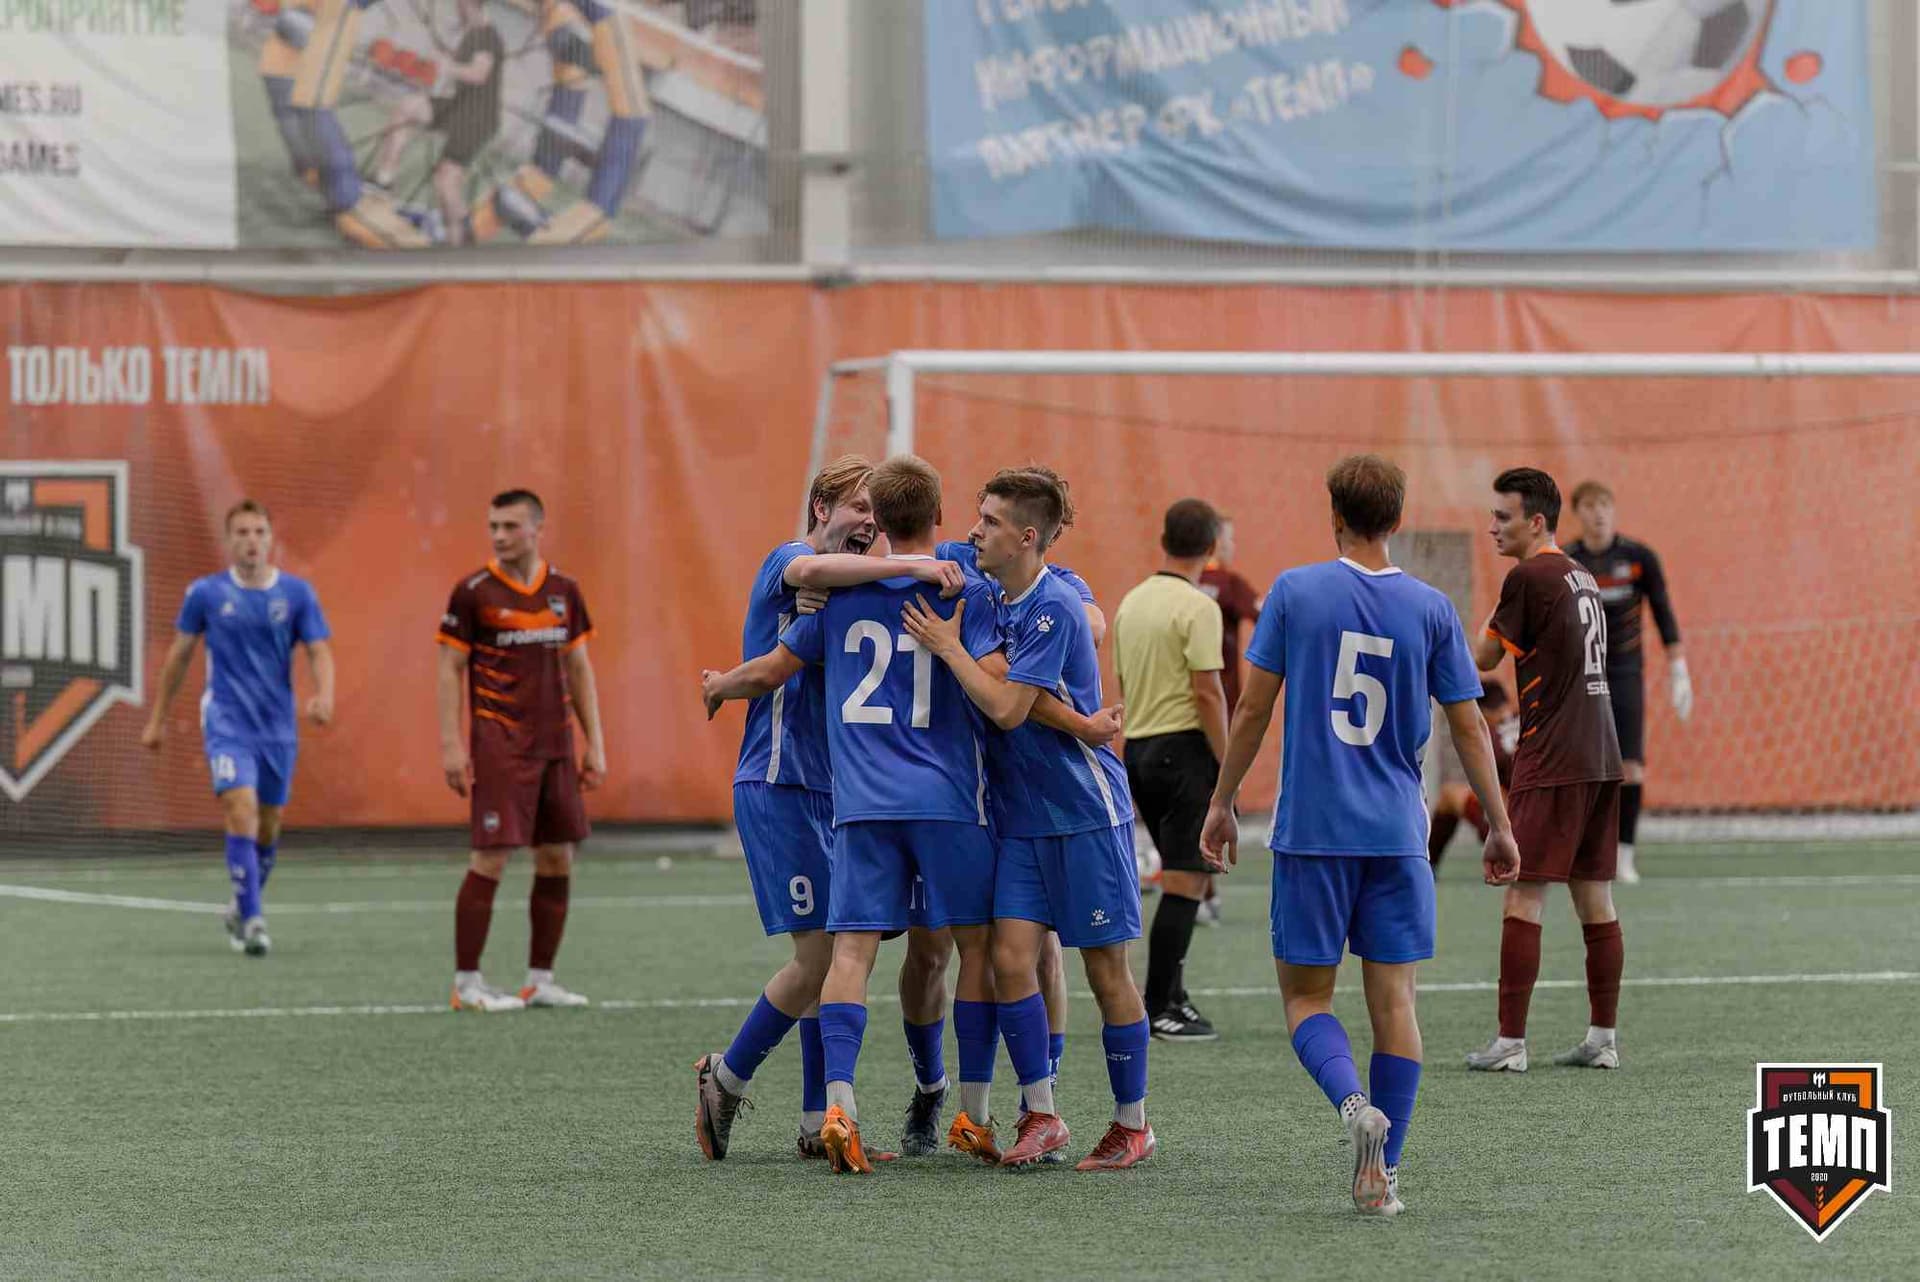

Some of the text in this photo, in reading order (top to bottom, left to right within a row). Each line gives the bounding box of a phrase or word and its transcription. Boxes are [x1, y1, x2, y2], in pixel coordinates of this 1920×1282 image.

[0, 0, 185, 36] РОПРИЯТИЕ
[8, 344, 152, 405] ТОЛЬКО
[841, 619, 934, 729] 21
[1331, 630, 1394, 746] 5
[789, 874, 814, 914] 9
